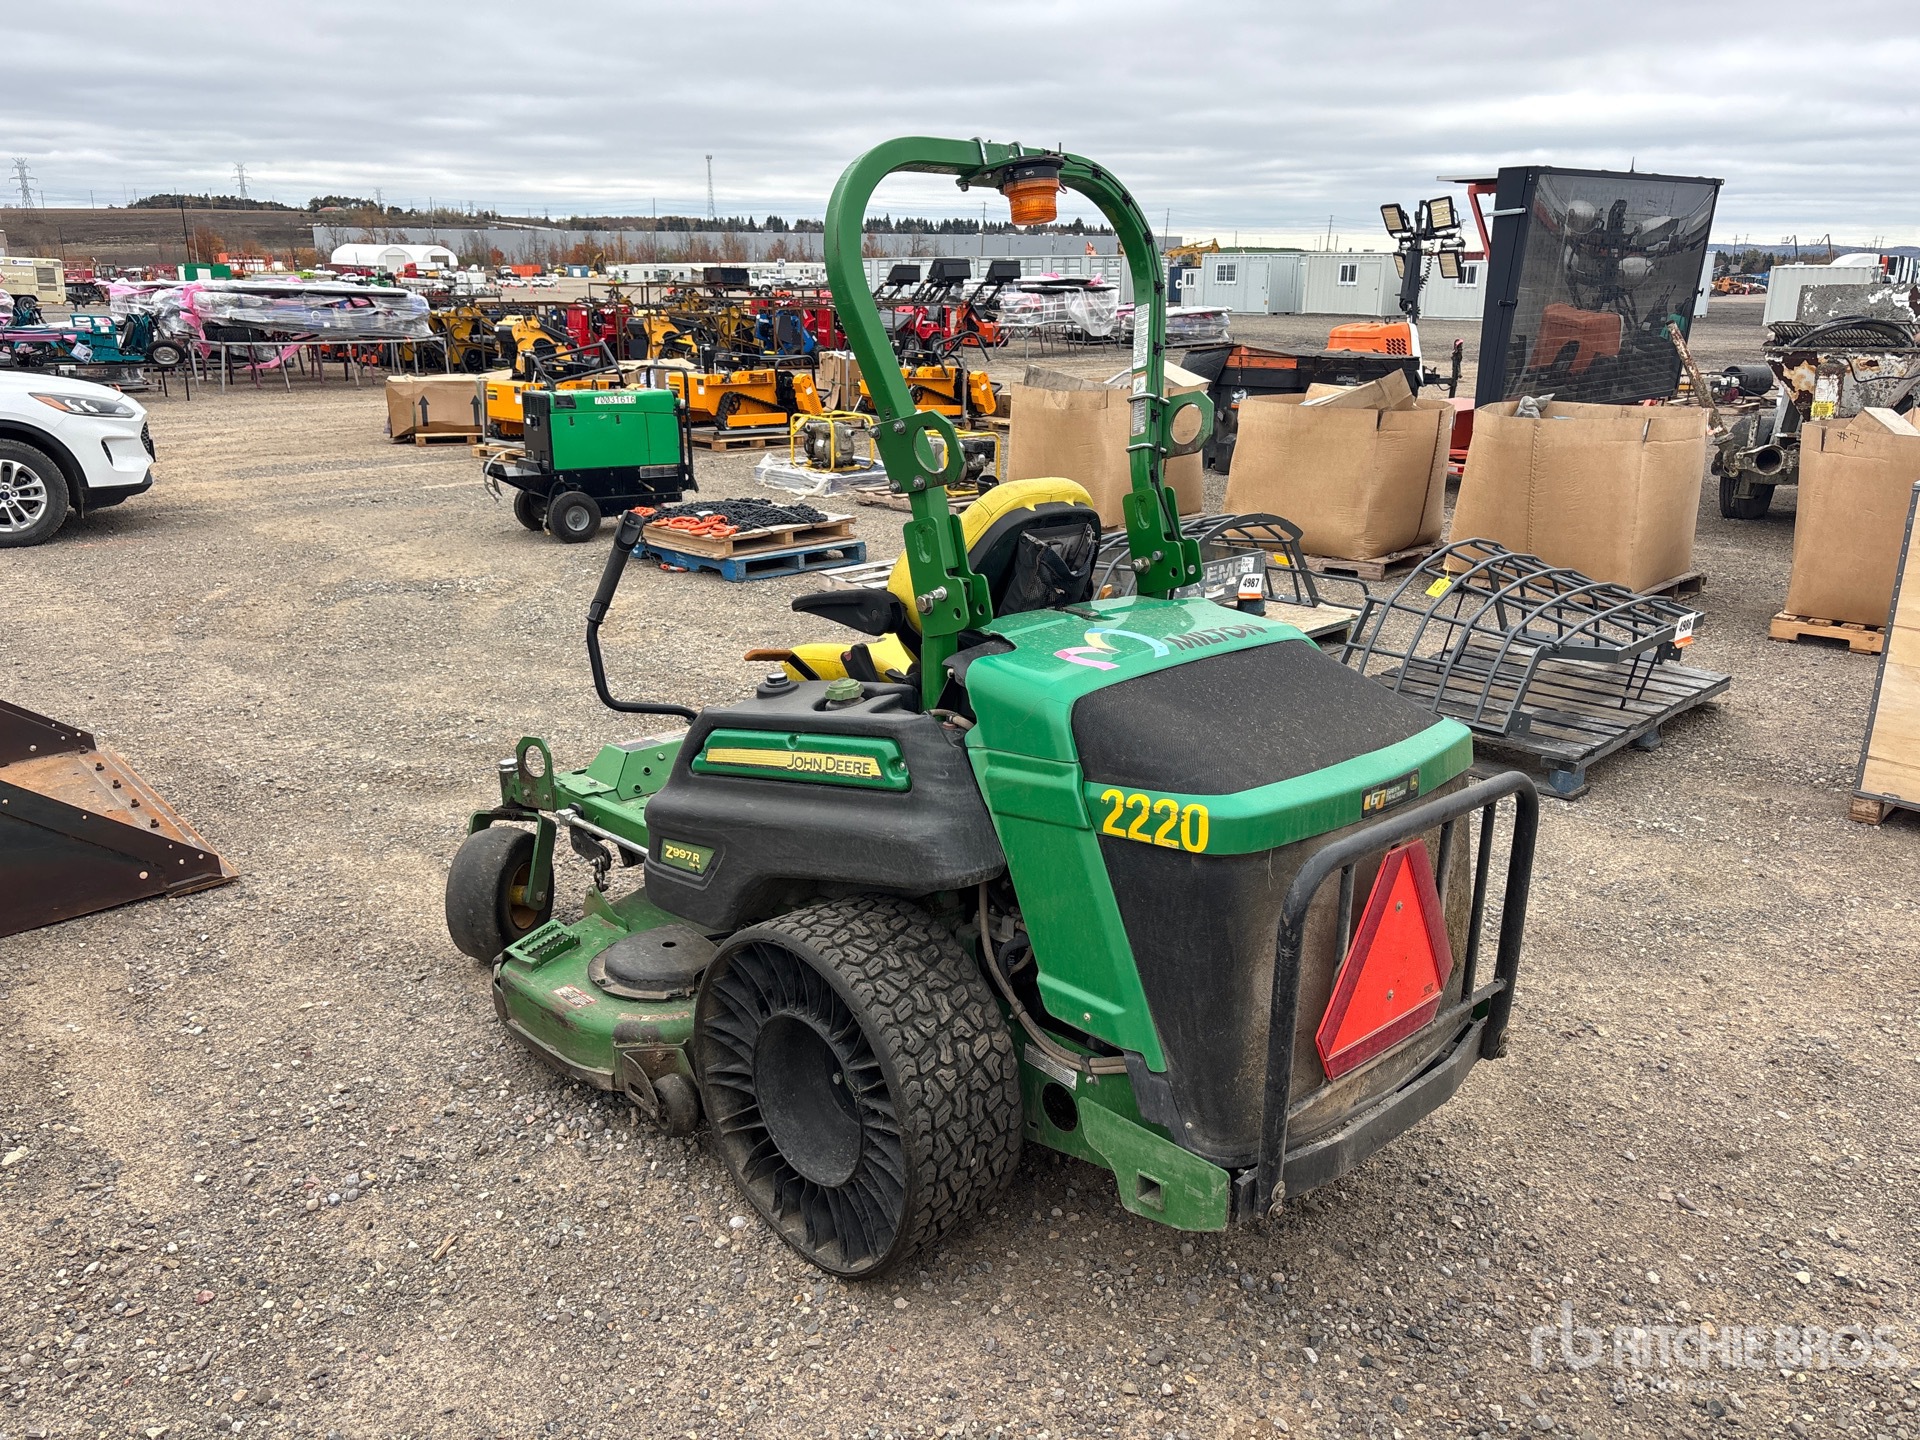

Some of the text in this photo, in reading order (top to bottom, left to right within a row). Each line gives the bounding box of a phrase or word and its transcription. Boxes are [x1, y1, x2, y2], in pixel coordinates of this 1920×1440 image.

[1837, 431, 1864, 449] #7
[1243, 577, 1260, 588] 4987
[1164, 623, 1268, 651] MILTON
[787, 754, 871, 775] JOHN DEERE
[1101, 788, 1209, 853] 2220
